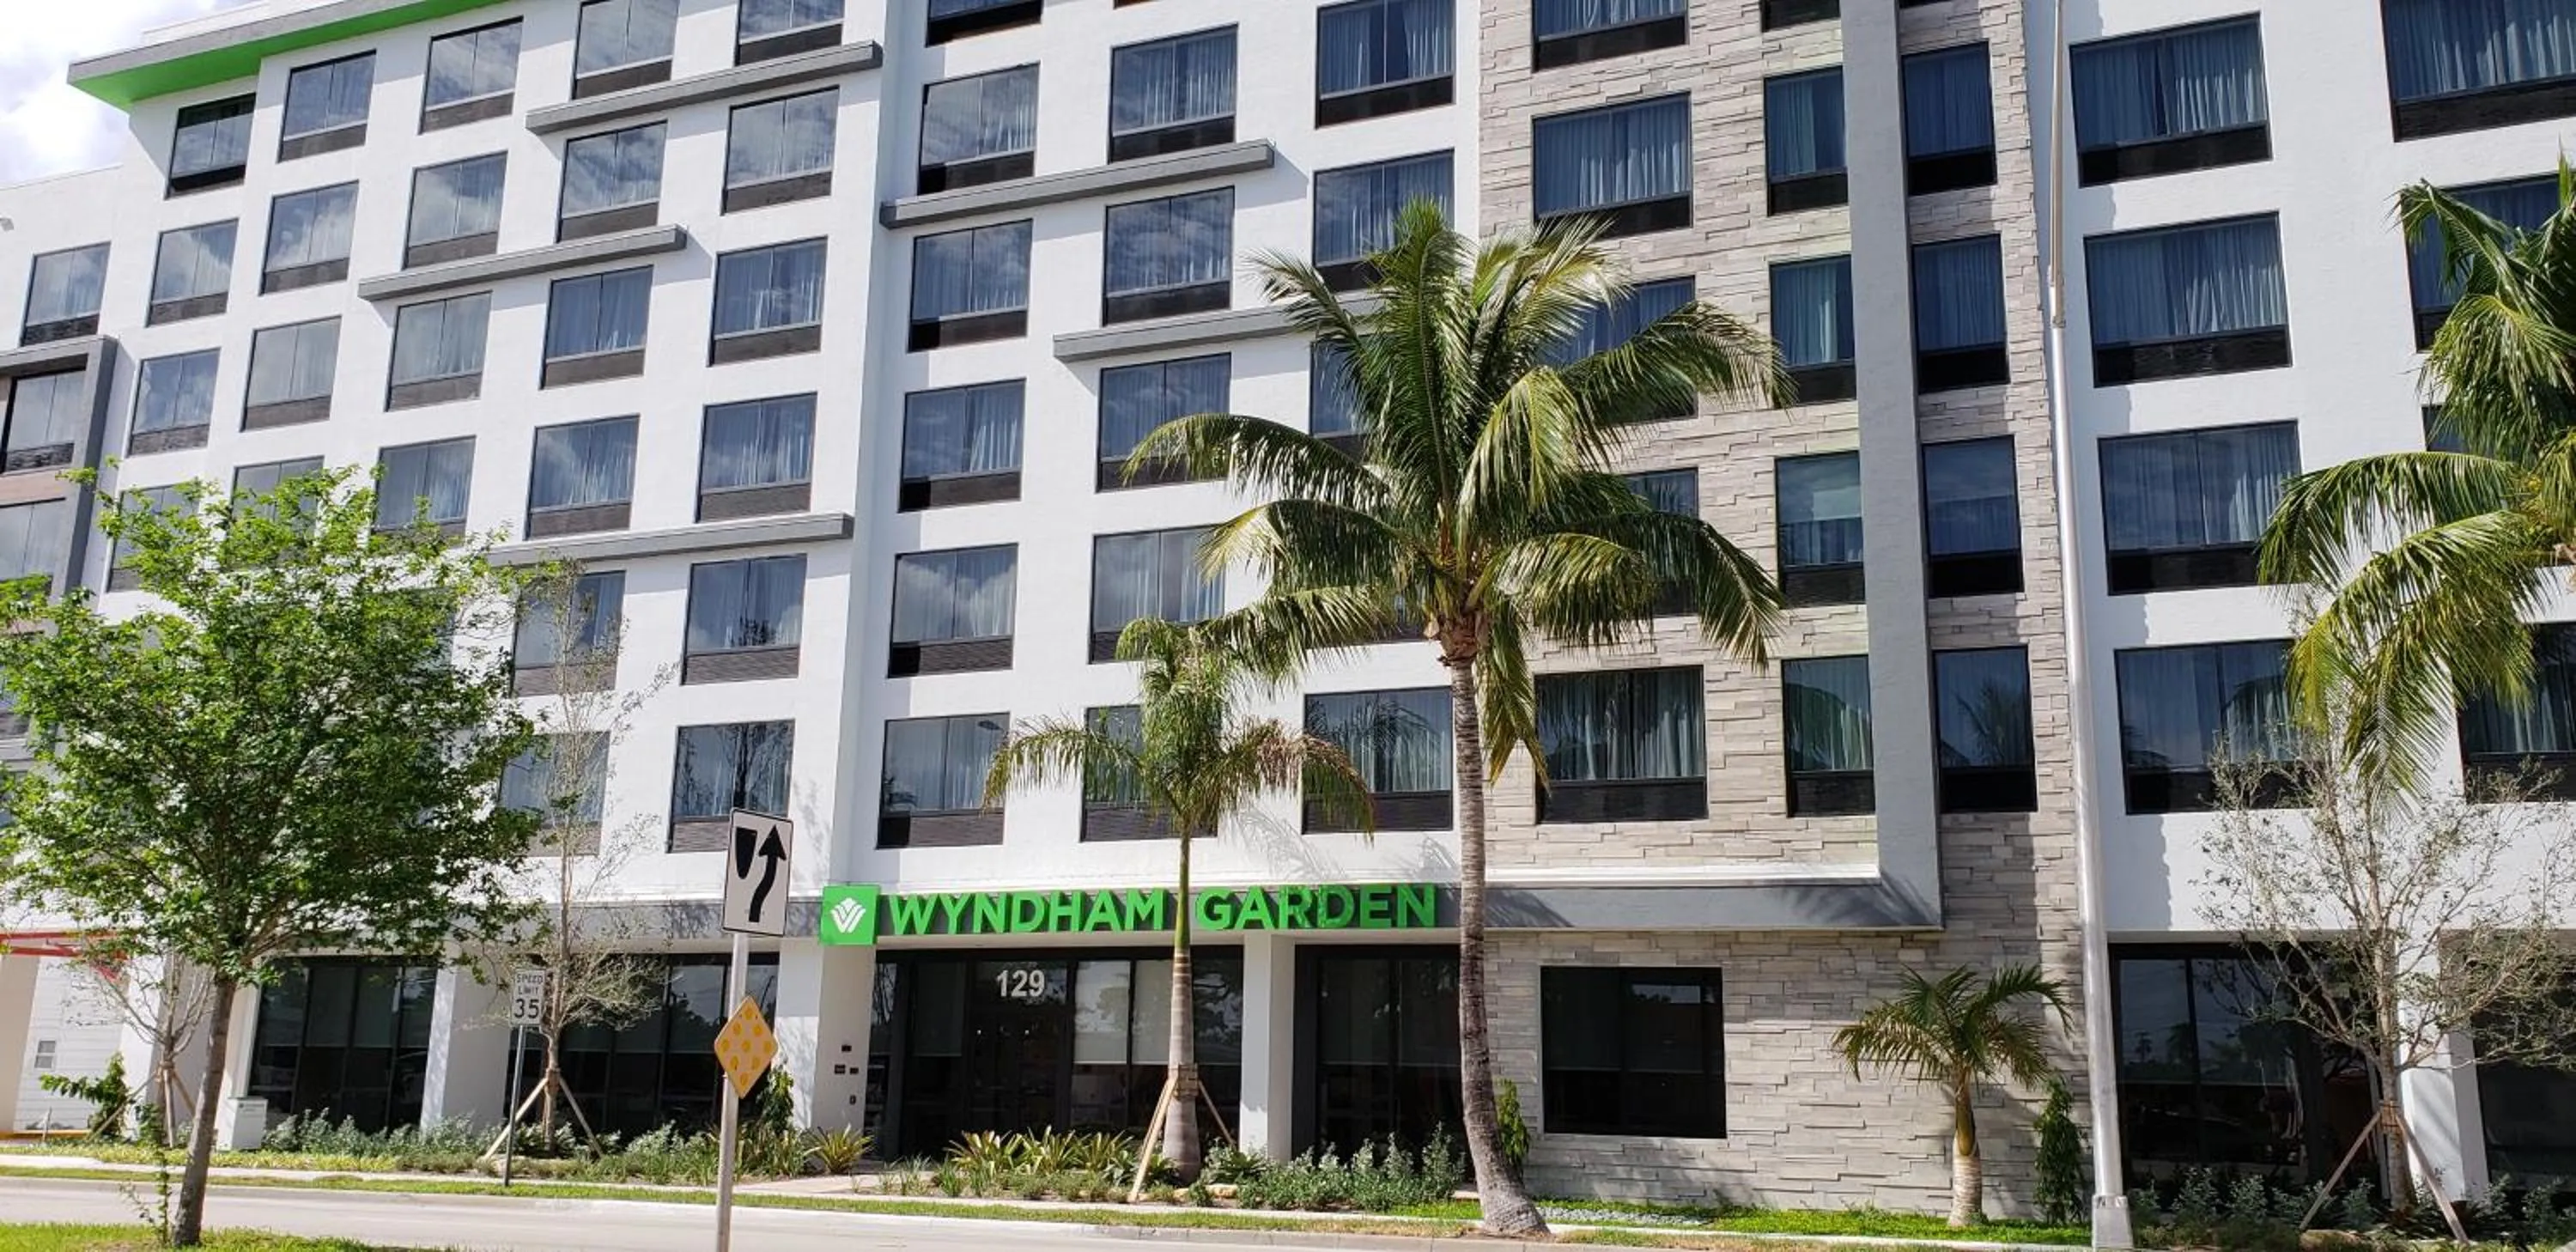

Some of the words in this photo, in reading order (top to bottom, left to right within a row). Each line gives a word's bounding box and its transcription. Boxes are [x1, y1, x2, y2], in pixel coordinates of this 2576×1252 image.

[888, 887, 1170, 935] WYNDHAM
[1195, 883, 1437, 931] GARDEN
[516, 973, 543, 984] SPEED
[996, 969, 1045, 997] 129
[519, 986, 539, 995] LIMIT
[514, 999, 539, 1018] 35
